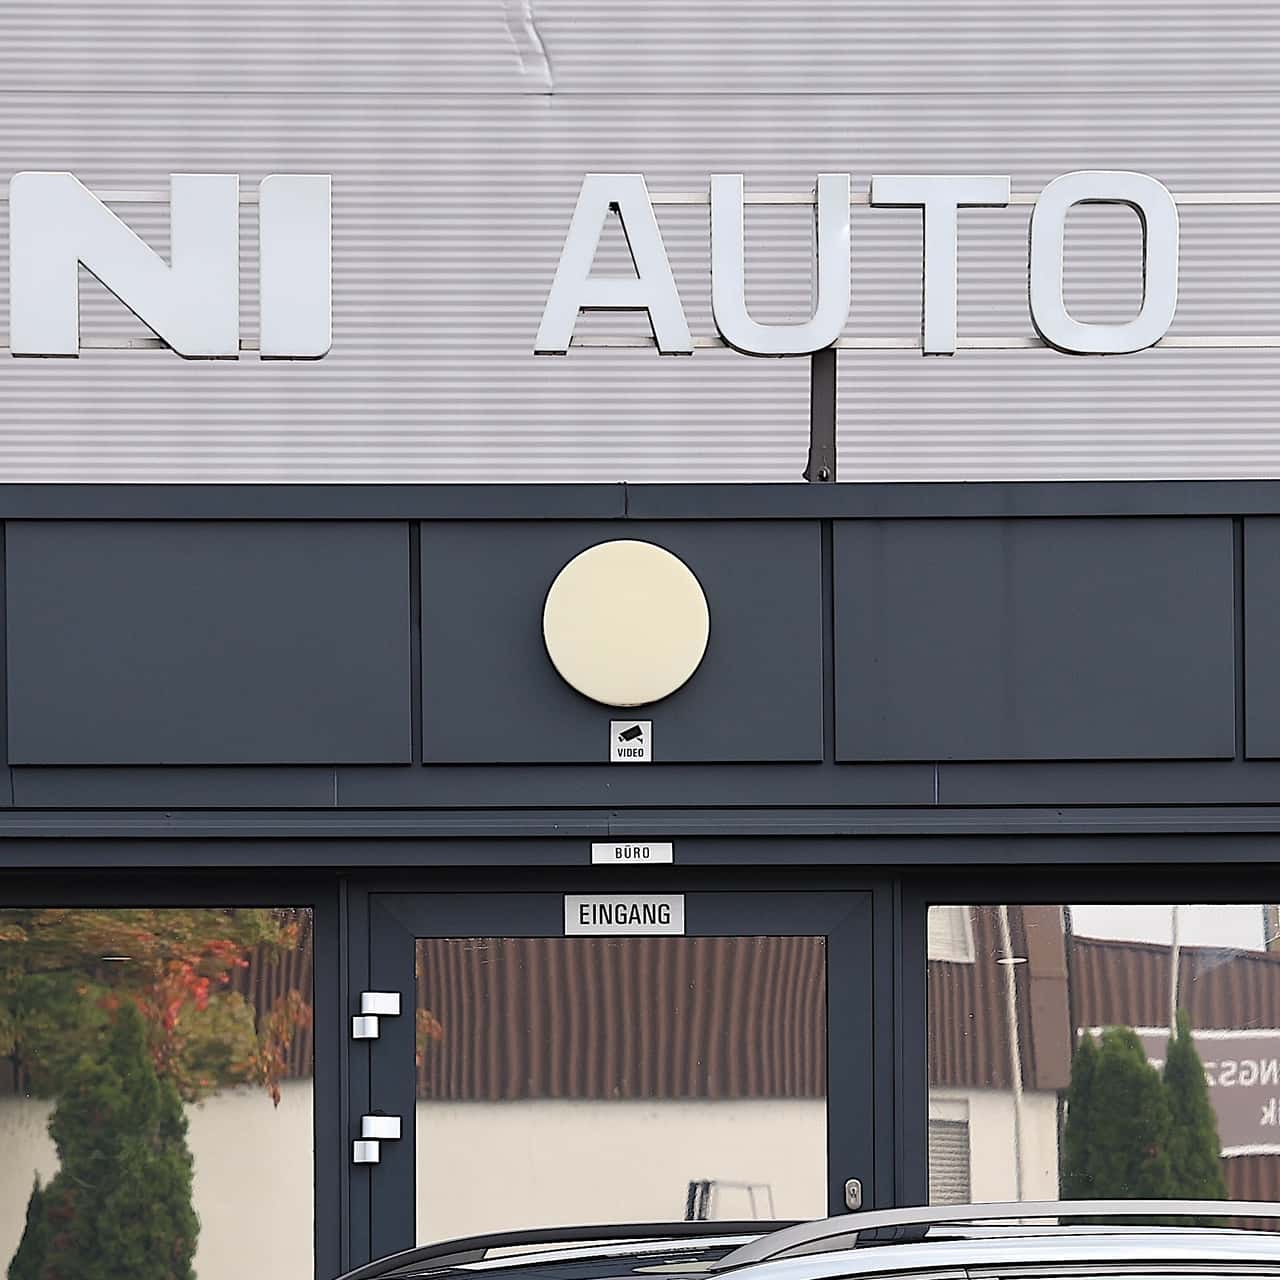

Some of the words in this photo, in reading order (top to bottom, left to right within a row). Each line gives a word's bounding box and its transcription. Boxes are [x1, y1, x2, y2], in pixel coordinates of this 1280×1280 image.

[533, 168, 1181, 358] AUTO
[617, 748, 645, 758] VIDEO
[615, 845, 651, 859] BÜRO
[579, 904, 671, 925] EINGANG
